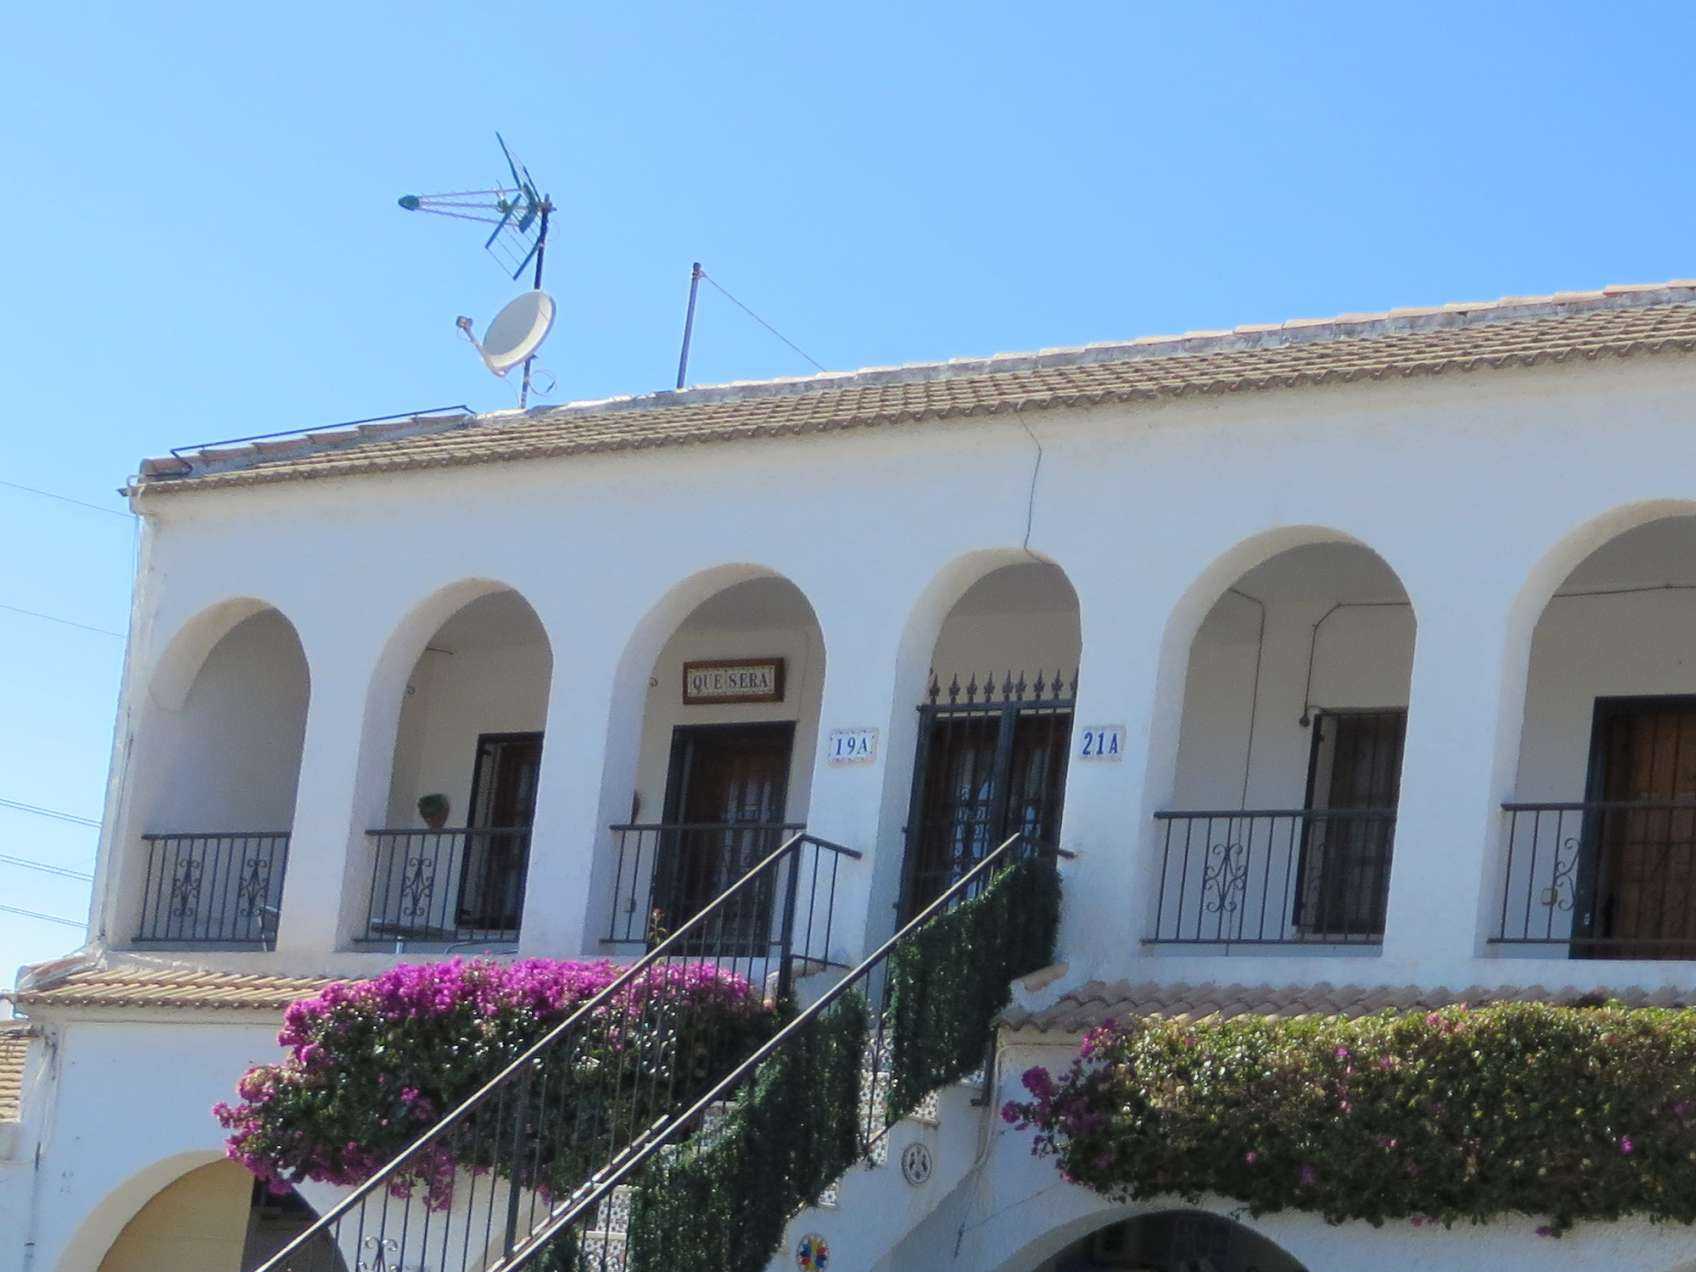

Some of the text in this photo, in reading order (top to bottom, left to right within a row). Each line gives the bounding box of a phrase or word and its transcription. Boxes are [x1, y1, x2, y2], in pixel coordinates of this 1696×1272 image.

[693, 674, 722, 693] QUE
[836, 736, 868, 755] 19A
[1082, 731, 1118, 755] 21A
